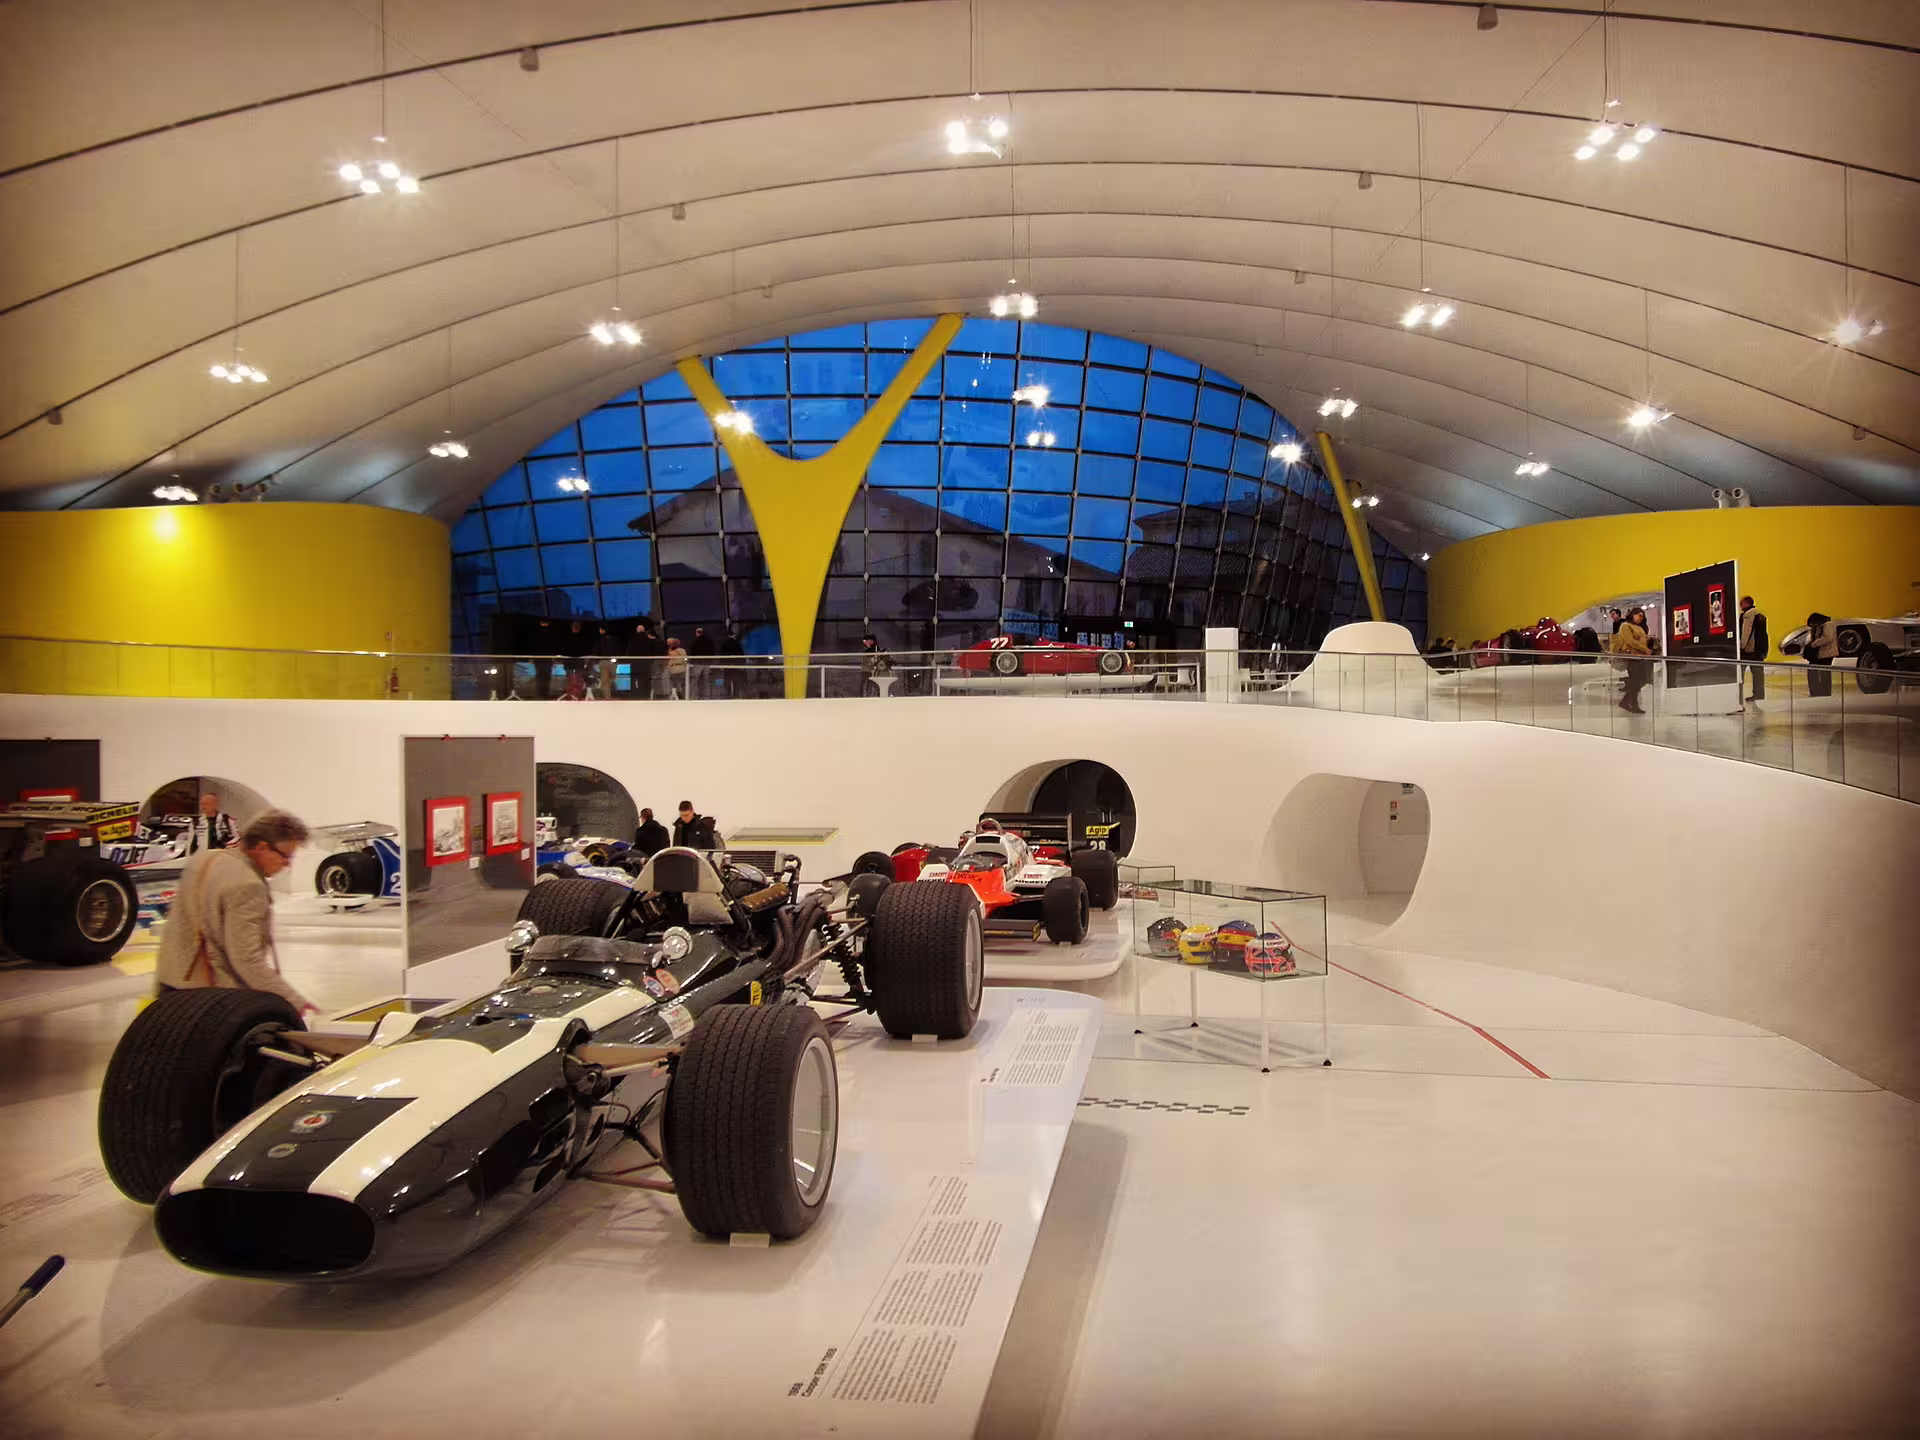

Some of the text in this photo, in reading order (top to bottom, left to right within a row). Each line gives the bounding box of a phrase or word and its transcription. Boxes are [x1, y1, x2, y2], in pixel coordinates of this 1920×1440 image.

[86, 804, 139, 821] MICHELIN
[1089, 826, 1107, 835] Agip
[1089, 840, 1107, 851] 28
